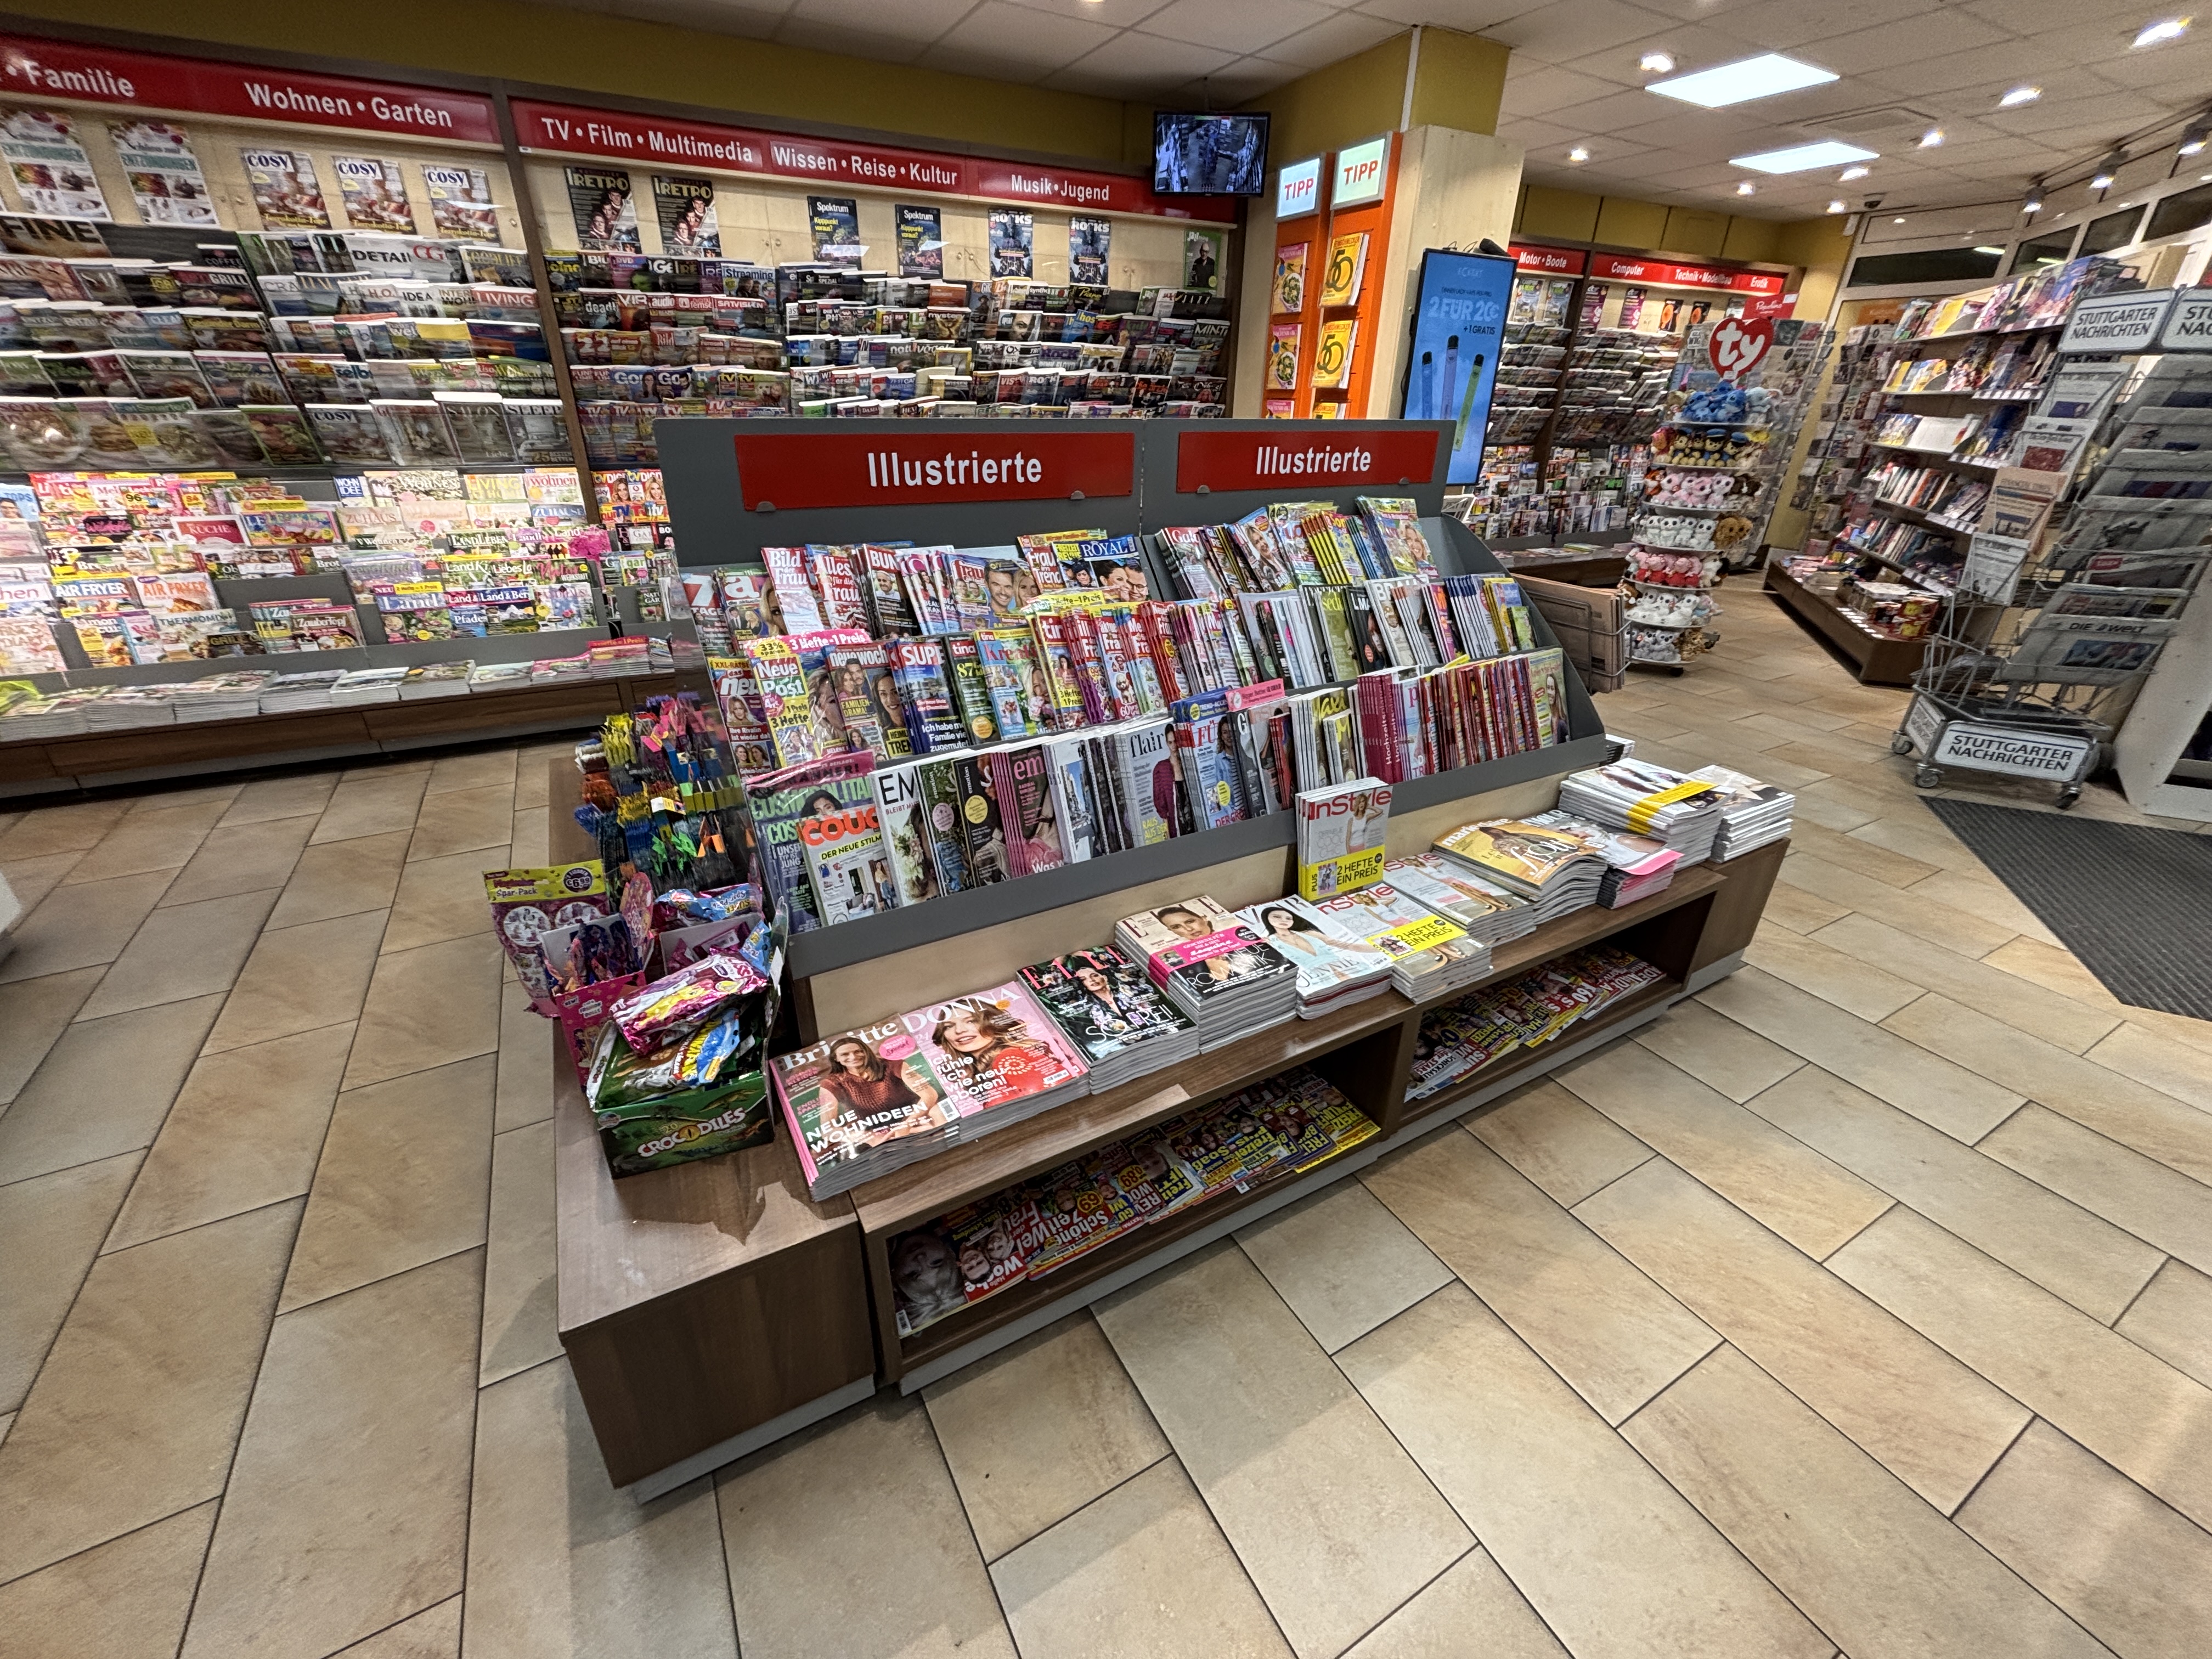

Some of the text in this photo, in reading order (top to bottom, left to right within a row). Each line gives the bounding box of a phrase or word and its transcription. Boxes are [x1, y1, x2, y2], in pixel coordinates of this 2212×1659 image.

[25, 60, 136, 99] Familie
[245, 82, 453, 128] Wohnen Garten
[541, 117, 753, 163] TV Film Multimedia
[247, 154, 289, 170] COSY
[338, 161, 379, 178] COSY
[774, 145, 957, 187] Wissen Reise Kultur
[427, 170, 465, 185] COSY
[1344, 159, 1379, 185] TIPP
[575, 171, 629, 191] RETRO
[1011, 174, 1110, 202] Musik Jugend
[1285, 177, 1314, 201] TIPP
[660, 180, 713, 200] RETRO
[816, 201, 849, 213] Spektrum
[904, 210, 934, 222] Spektrum
[1520, 252, 1567, 268] Motor Boote
[1611, 262, 1645, 275] Computer
[210, 274, 247, 285] GRILL
[725, 268, 774, 280] Streaming
[1675, 268, 1733, 285] Technik Modellbau
[1750, 276, 1768, 289] Erotik
[476, 291, 535, 307] LIVING
[651, 296, 675, 307] audio
[1427, 296, 1440, 318] 2
[1440, 297, 1474, 321] FÜR
[2076, 307, 2158, 326] STUTTGARTER
[1472, 325, 1496, 335] GRATIS
[2070, 322, 2152, 340] NACHRICHTEN
[1717, 321, 1764, 380] ty
[1255, 445, 1372, 475] Illustrierte
[867, 451, 1042, 487] Illustrierte
[336, 478, 360, 488] WOHN
[529, 475, 577, 487] wohnen
[126, 493, 143, 502] 96
[339, 487, 363, 495] IDEE
[1082, 540, 1129, 557] ROYAL
[769, 550, 802, 568] Bild
[815, 556, 851, 575] Alles
[1028, 550, 1056, 567] Frau
[774, 568, 808, 585] Frau
[832, 577, 854, 586] für die
[56, 582, 127, 597] AIR FRYER
[143, 583, 165, 597] AIR
[375, 585, 394, 594] NEU
[481, 593, 504, 602] Land
[684, 576, 713, 607] 7
[824, 585, 862, 602] Frau
[693, 607, 724, 616] TAGE
[980, 633, 994, 641] tina
[759, 641, 783, 652] 33%
[952, 643, 977, 656] tina
[758, 660, 799, 679] Neue
[957, 662, 974, 678] 87
[763, 679, 805, 696] Post
[1065, 689, 1081, 698] Hefte
[841, 700, 873, 710] FAMILIEN-
[843, 707, 868, 716] DRAMA!
[770, 713, 810, 728] 3 Hefte
[922, 723, 956, 733] Ich habe
[929, 733, 955, 742] Familie
[1130, 731, 1165, 758] flair
[1951, 734, 2073, 761] STUTTGARTER
[1948, 744, 2070, 771] NACHRICHTEN
[885, 804, 906, 815] BLEIBT
[821, 849, 837, 860] DER
[838, 843, 860, 855] NEUE
[781, 858, 802, 869] JUNG
[1032, 861, 1056, 873] Was
[1337, 857, 1373, 876] 2 HEFTE
[1336, 865, 1378, 885] EIN PREIS
[496, 888, 538, 898] Spar-Pack
[1404, 926, 1453, 947] EIN PREIS
[1406, 923, 1435, 939] HEFTE
[901, 987, 1022, 1034] DONNA
[1086, 1003, 1177, 1044] SO FREI!
[783, 1022, 899, 1071] Briitte
[936, 1056, 974, 1075] fühle
[1415, 1056, 1438, 1075] STARS
[945, 1079, 973, 1093] wie
[805, 1110, 857, 1142] NEUE
[810, 1101, 928, 1153] WOHNIDEEN
